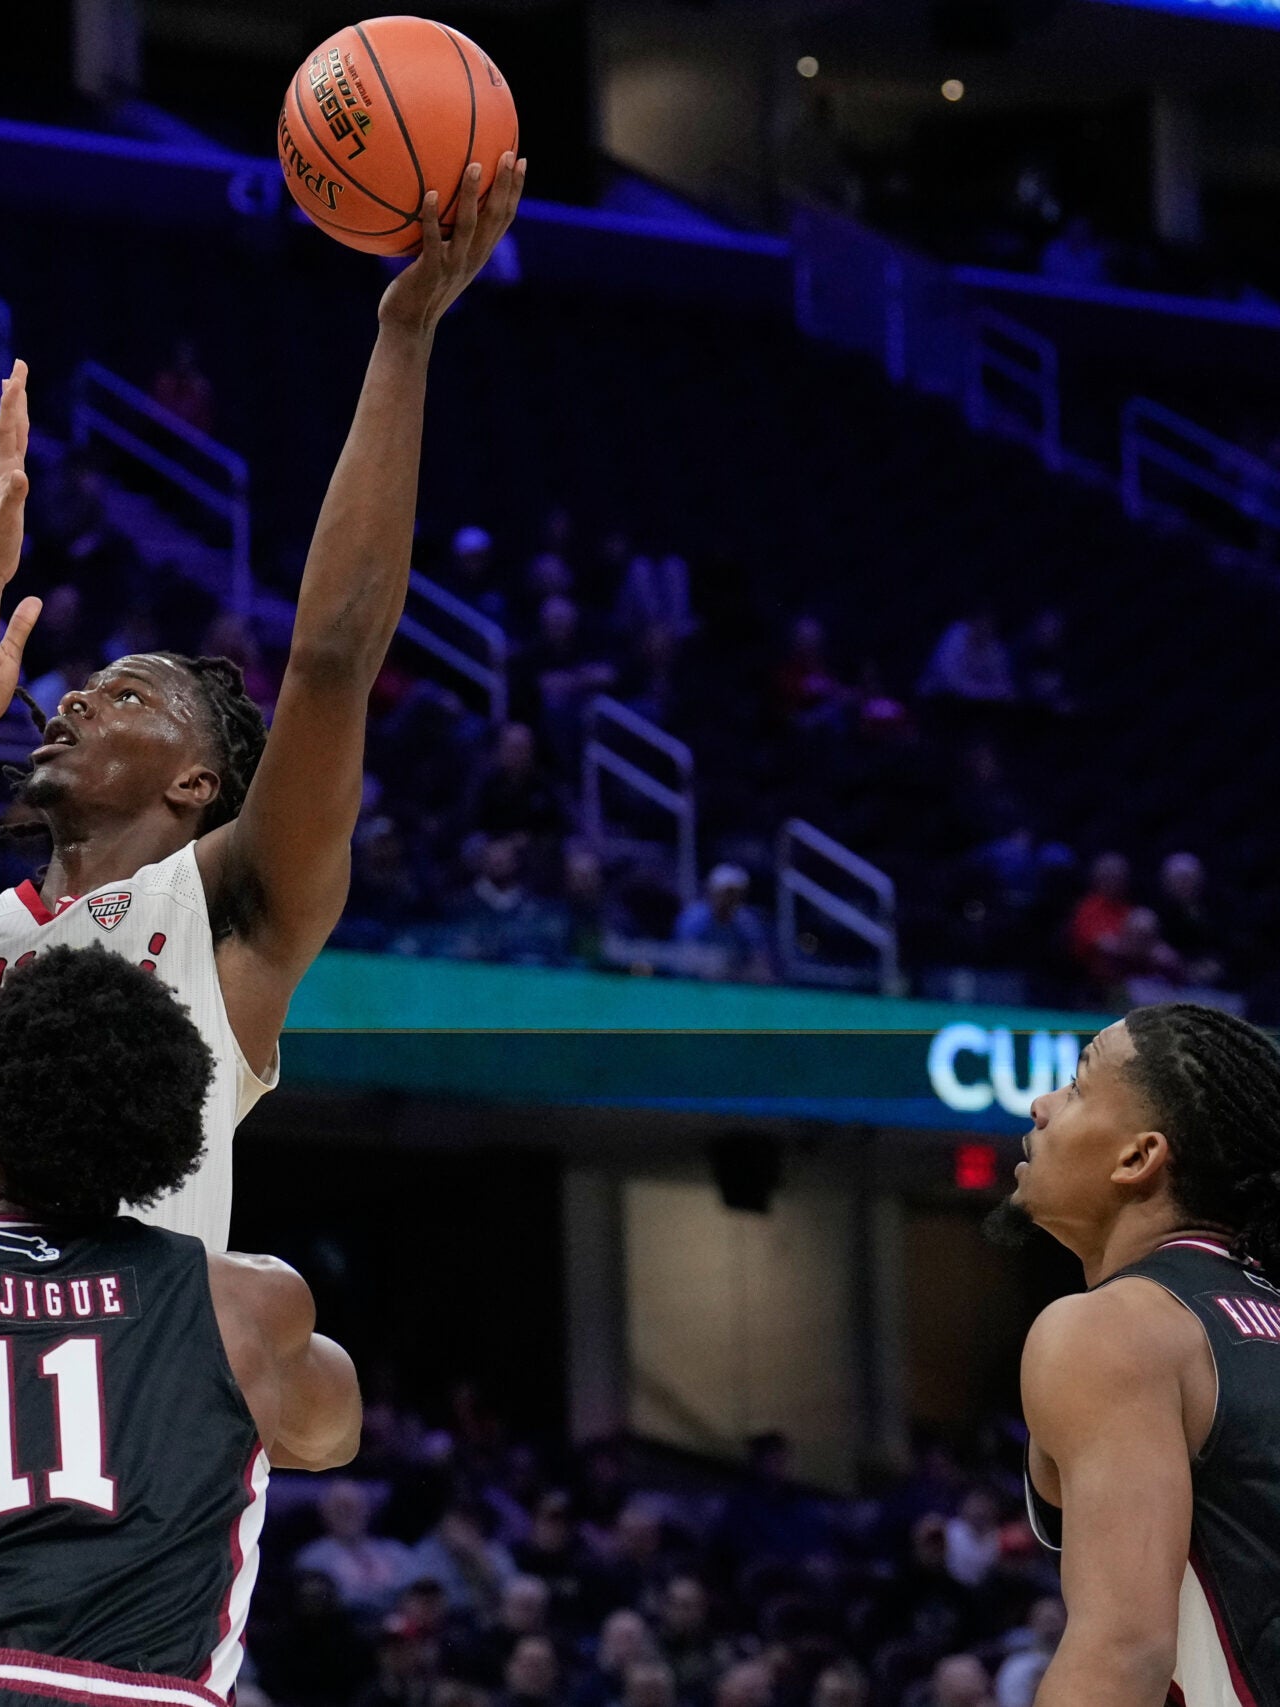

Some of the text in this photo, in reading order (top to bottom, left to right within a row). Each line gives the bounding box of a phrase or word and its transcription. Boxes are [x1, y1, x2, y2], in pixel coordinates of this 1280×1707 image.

[328, 47, 357, 109] 1000
[278, 106, 344, 211] SPALDI
[90, 900, 130, 916] MAC
